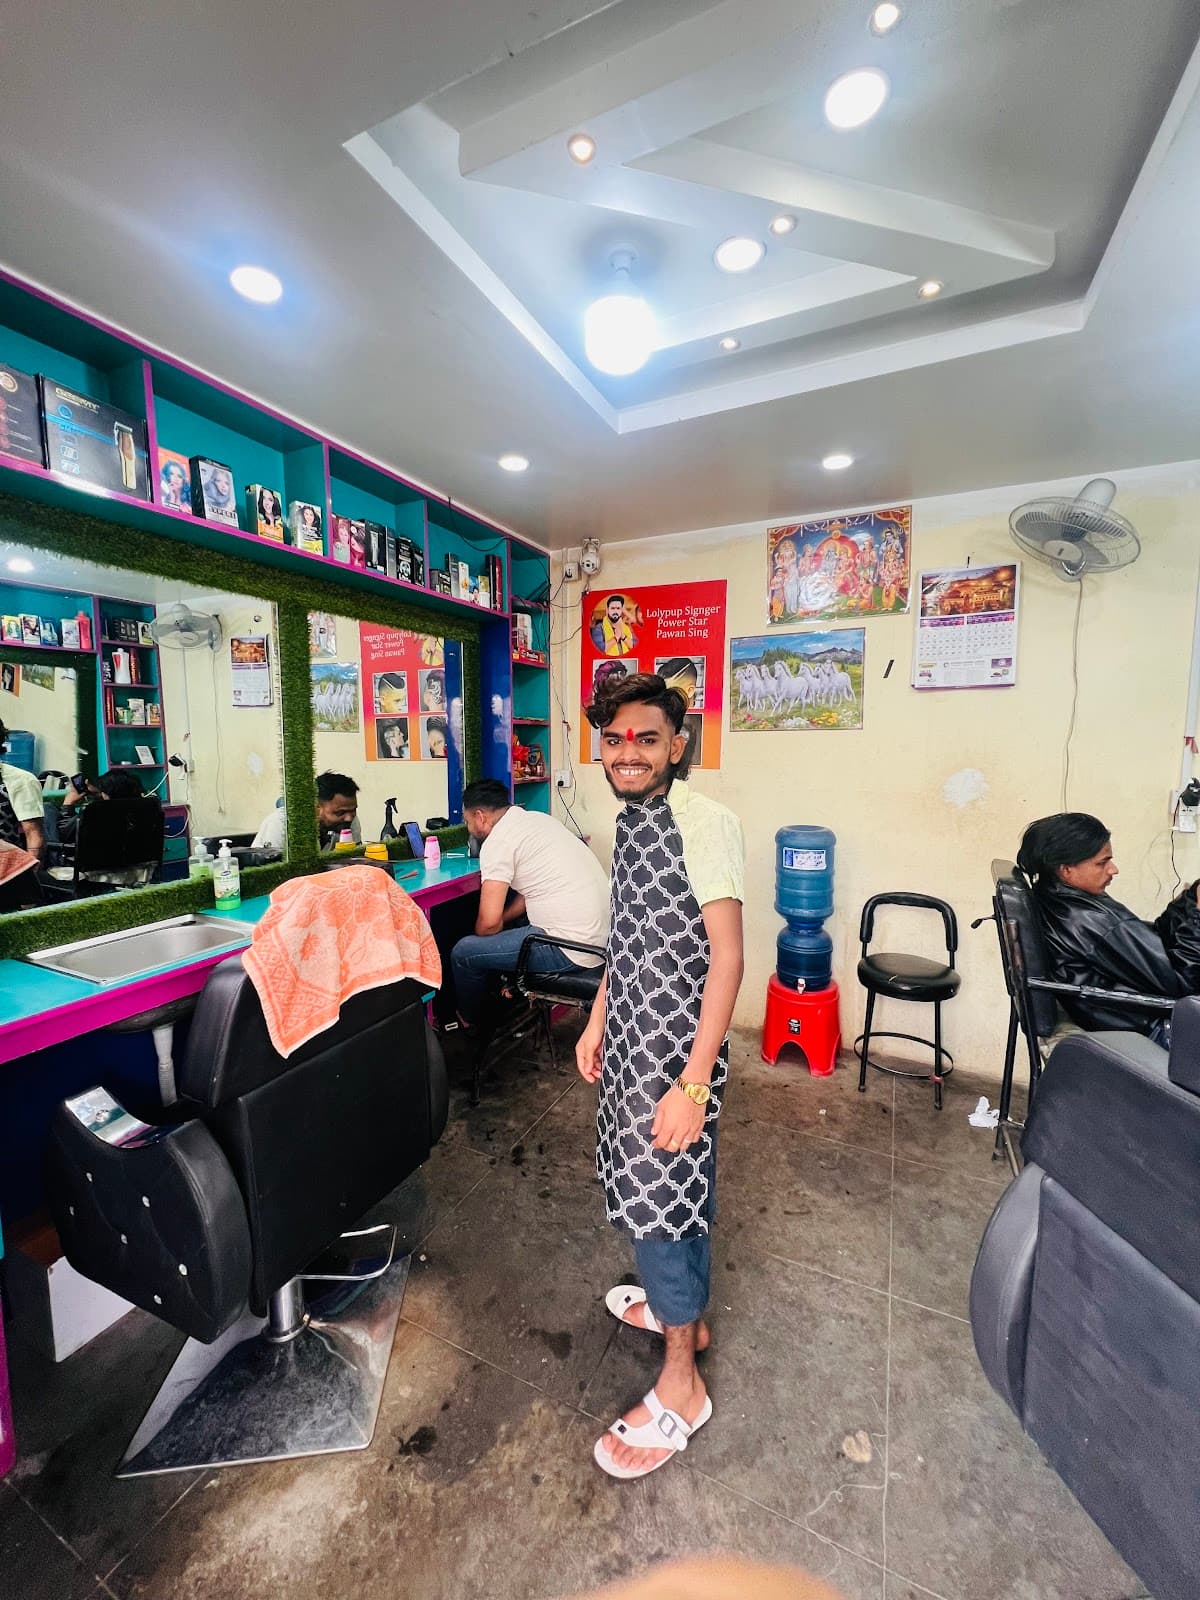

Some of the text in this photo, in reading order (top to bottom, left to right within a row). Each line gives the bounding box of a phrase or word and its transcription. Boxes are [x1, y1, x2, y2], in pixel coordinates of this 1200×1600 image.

[646, 606, 721, 618] Lolypup Signger
[657, 616, 709, 628] Power Star
[656, 627, 709, 639] Pawan Sing
